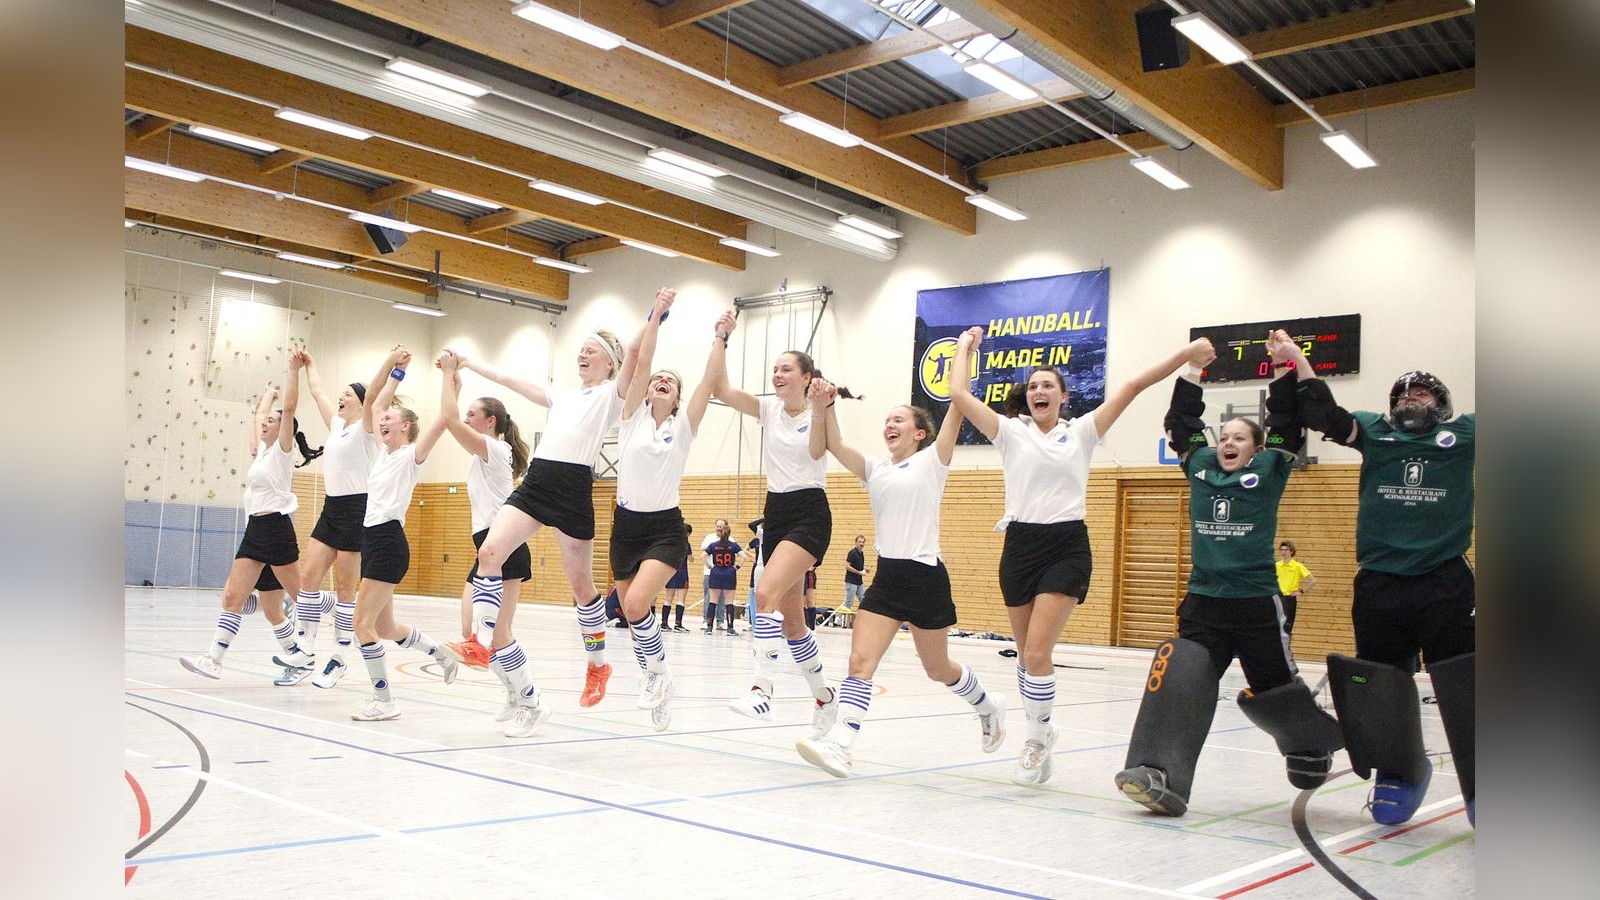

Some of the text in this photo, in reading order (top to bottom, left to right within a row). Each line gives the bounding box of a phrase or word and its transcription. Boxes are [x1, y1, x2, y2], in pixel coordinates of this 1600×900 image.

[987, 310, 1100, 337] HANDBALL.
[1233, 346, 1243, 361] 7
[1302, 341, 1312, 356] 2
[985, 349, 1043, 369] MADE
[1049, 346, 1072, 366] IN
[1406, 489, 1447, 497] RESTAURANT
[716, 553, 732, 566] 58
[1148, 643, 1174, 692] OBO
